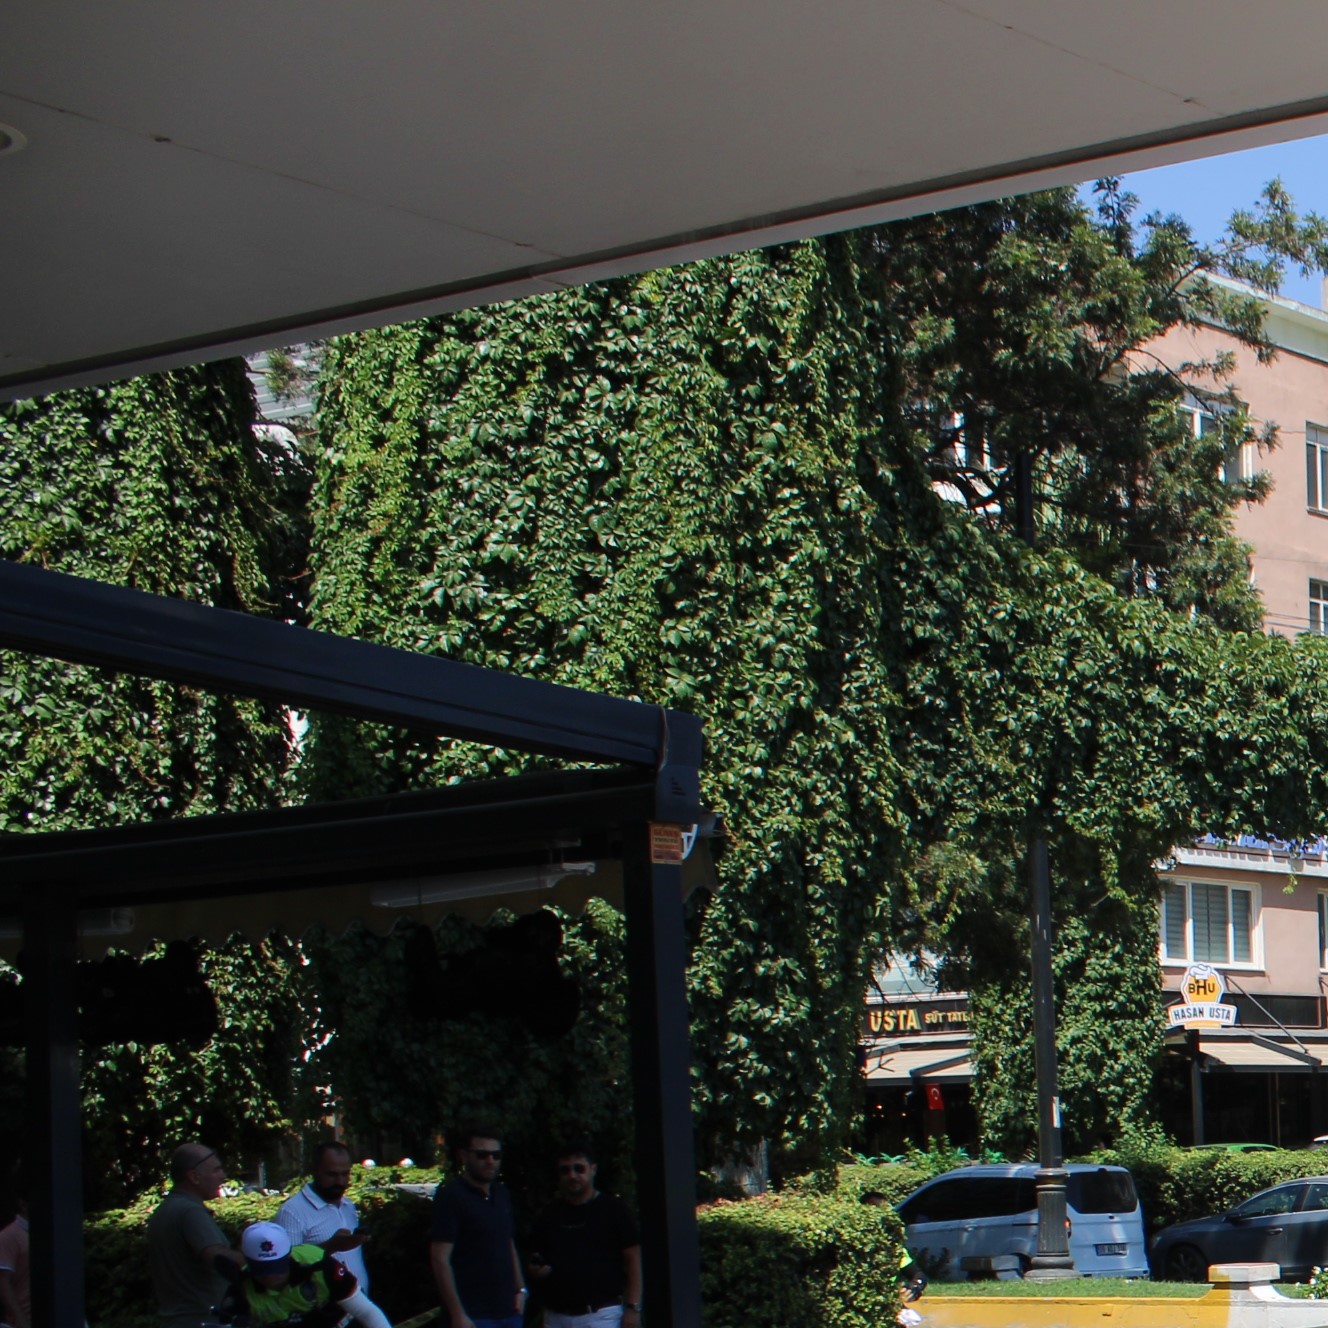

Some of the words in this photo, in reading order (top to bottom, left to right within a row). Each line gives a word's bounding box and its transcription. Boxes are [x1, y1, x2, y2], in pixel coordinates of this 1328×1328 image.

[870, 1008, 921, 1032] USTA
[925, 1010, 945, 1023] SÜT
[1174, 1007, 1205, 1020] HASAN
[1210, 1007, 1231, 1020] USTA
